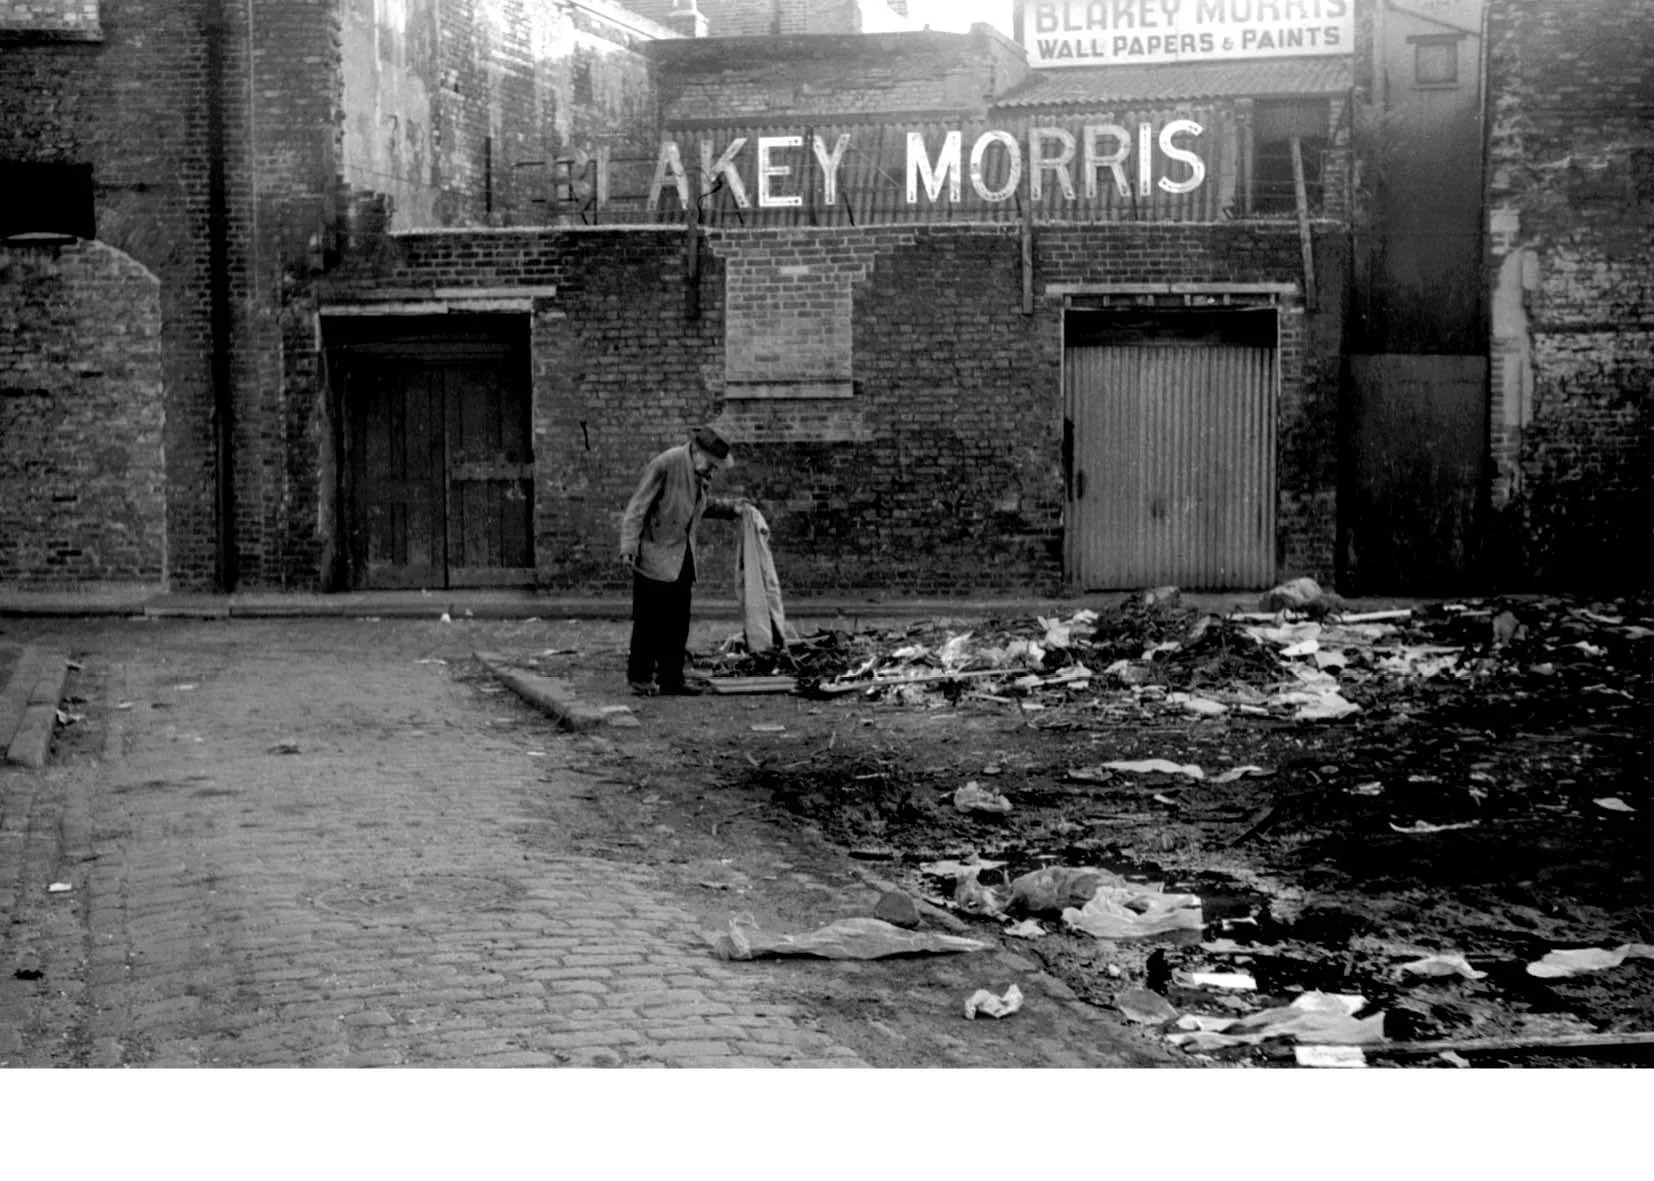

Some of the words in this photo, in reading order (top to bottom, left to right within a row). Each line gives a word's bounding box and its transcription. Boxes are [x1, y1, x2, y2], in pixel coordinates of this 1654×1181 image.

[1035, 0, 1180, 33] BLAKEY
[1037, 39, 1104, 59] WALL
[1113, 33, 1214, 56] PAPERS
[1222, 37, 1235, 51] &
[1242, 26, 1341, 50] PAINTS
[906, 119, 1206, 203] MORRIS
